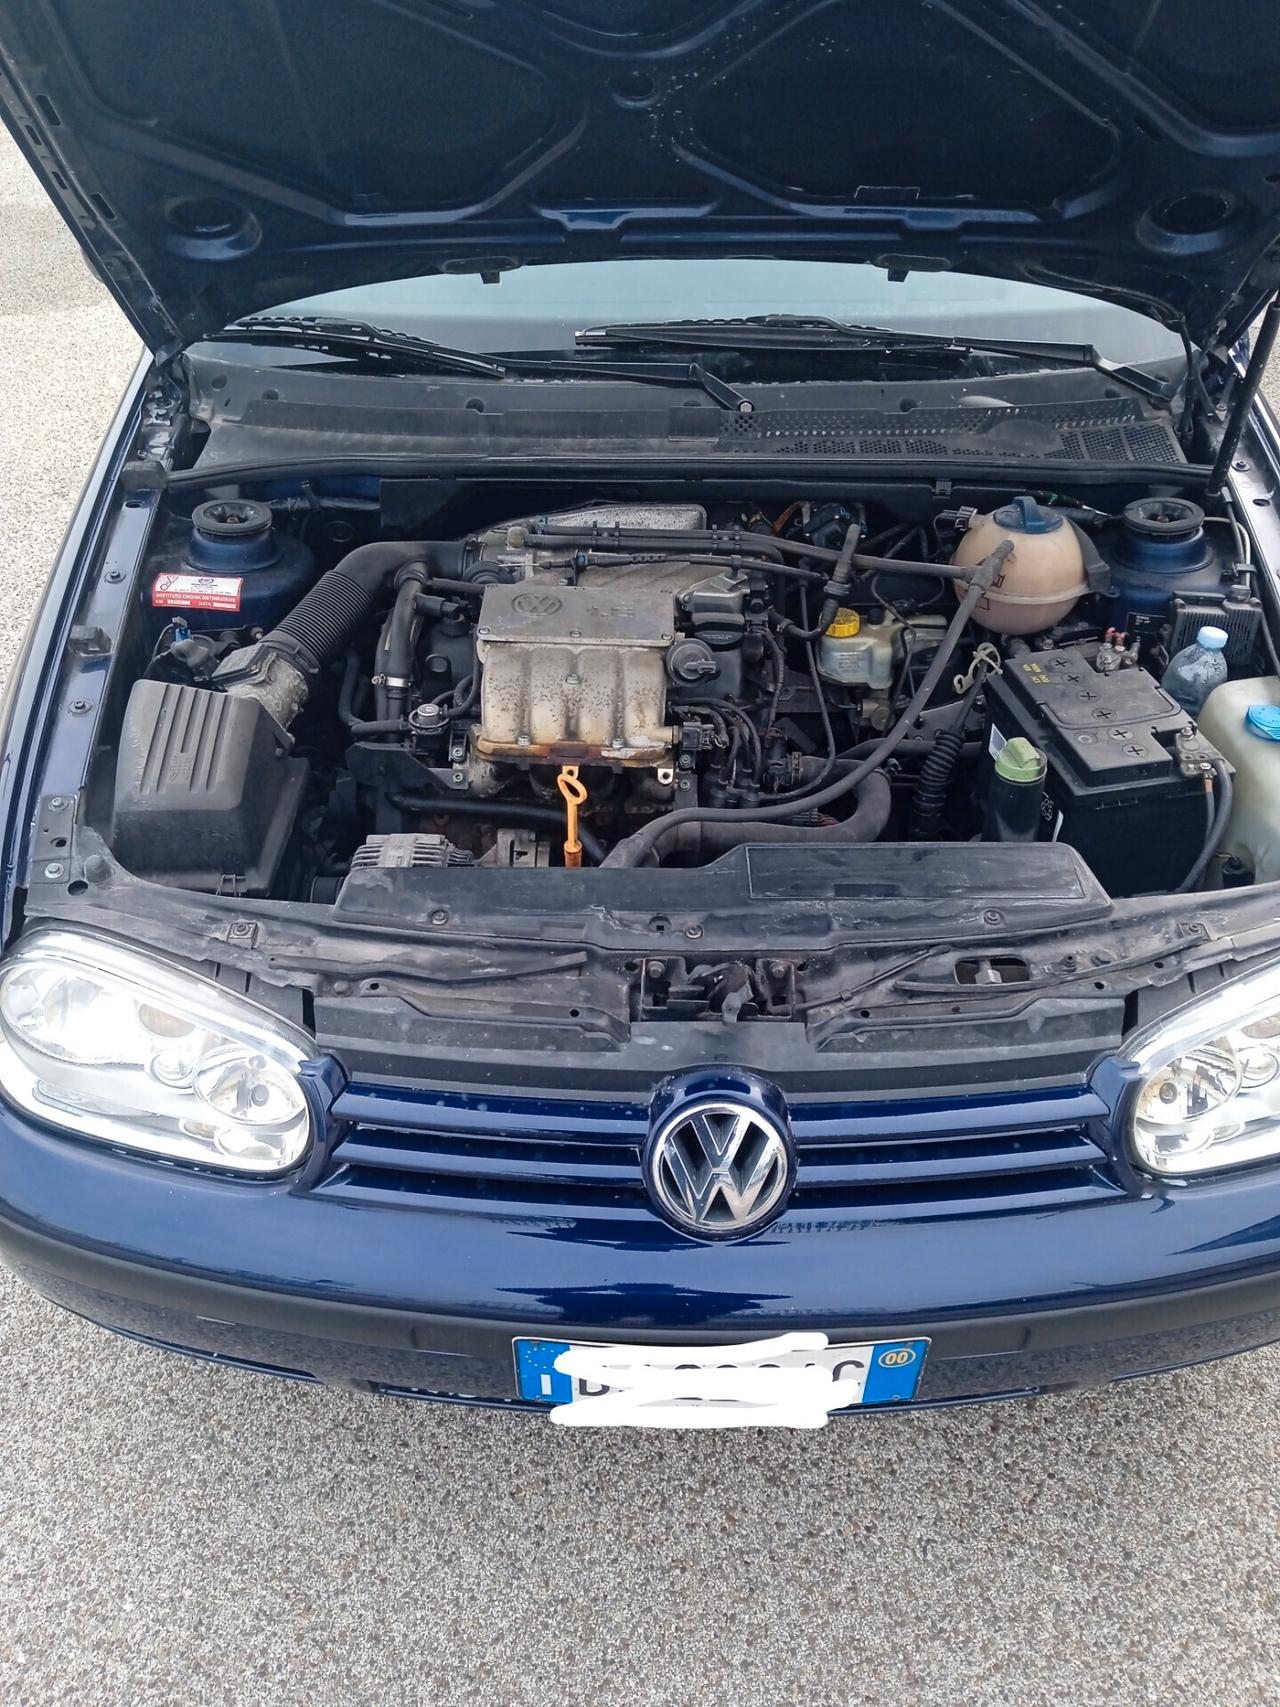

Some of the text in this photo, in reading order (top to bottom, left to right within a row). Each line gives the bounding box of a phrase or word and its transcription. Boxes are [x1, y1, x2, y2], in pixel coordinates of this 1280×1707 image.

[512, 592, 563, 617] VW
[653, 1103, 788, 1231] VW
[885, 1352, 908, 1365] 00
